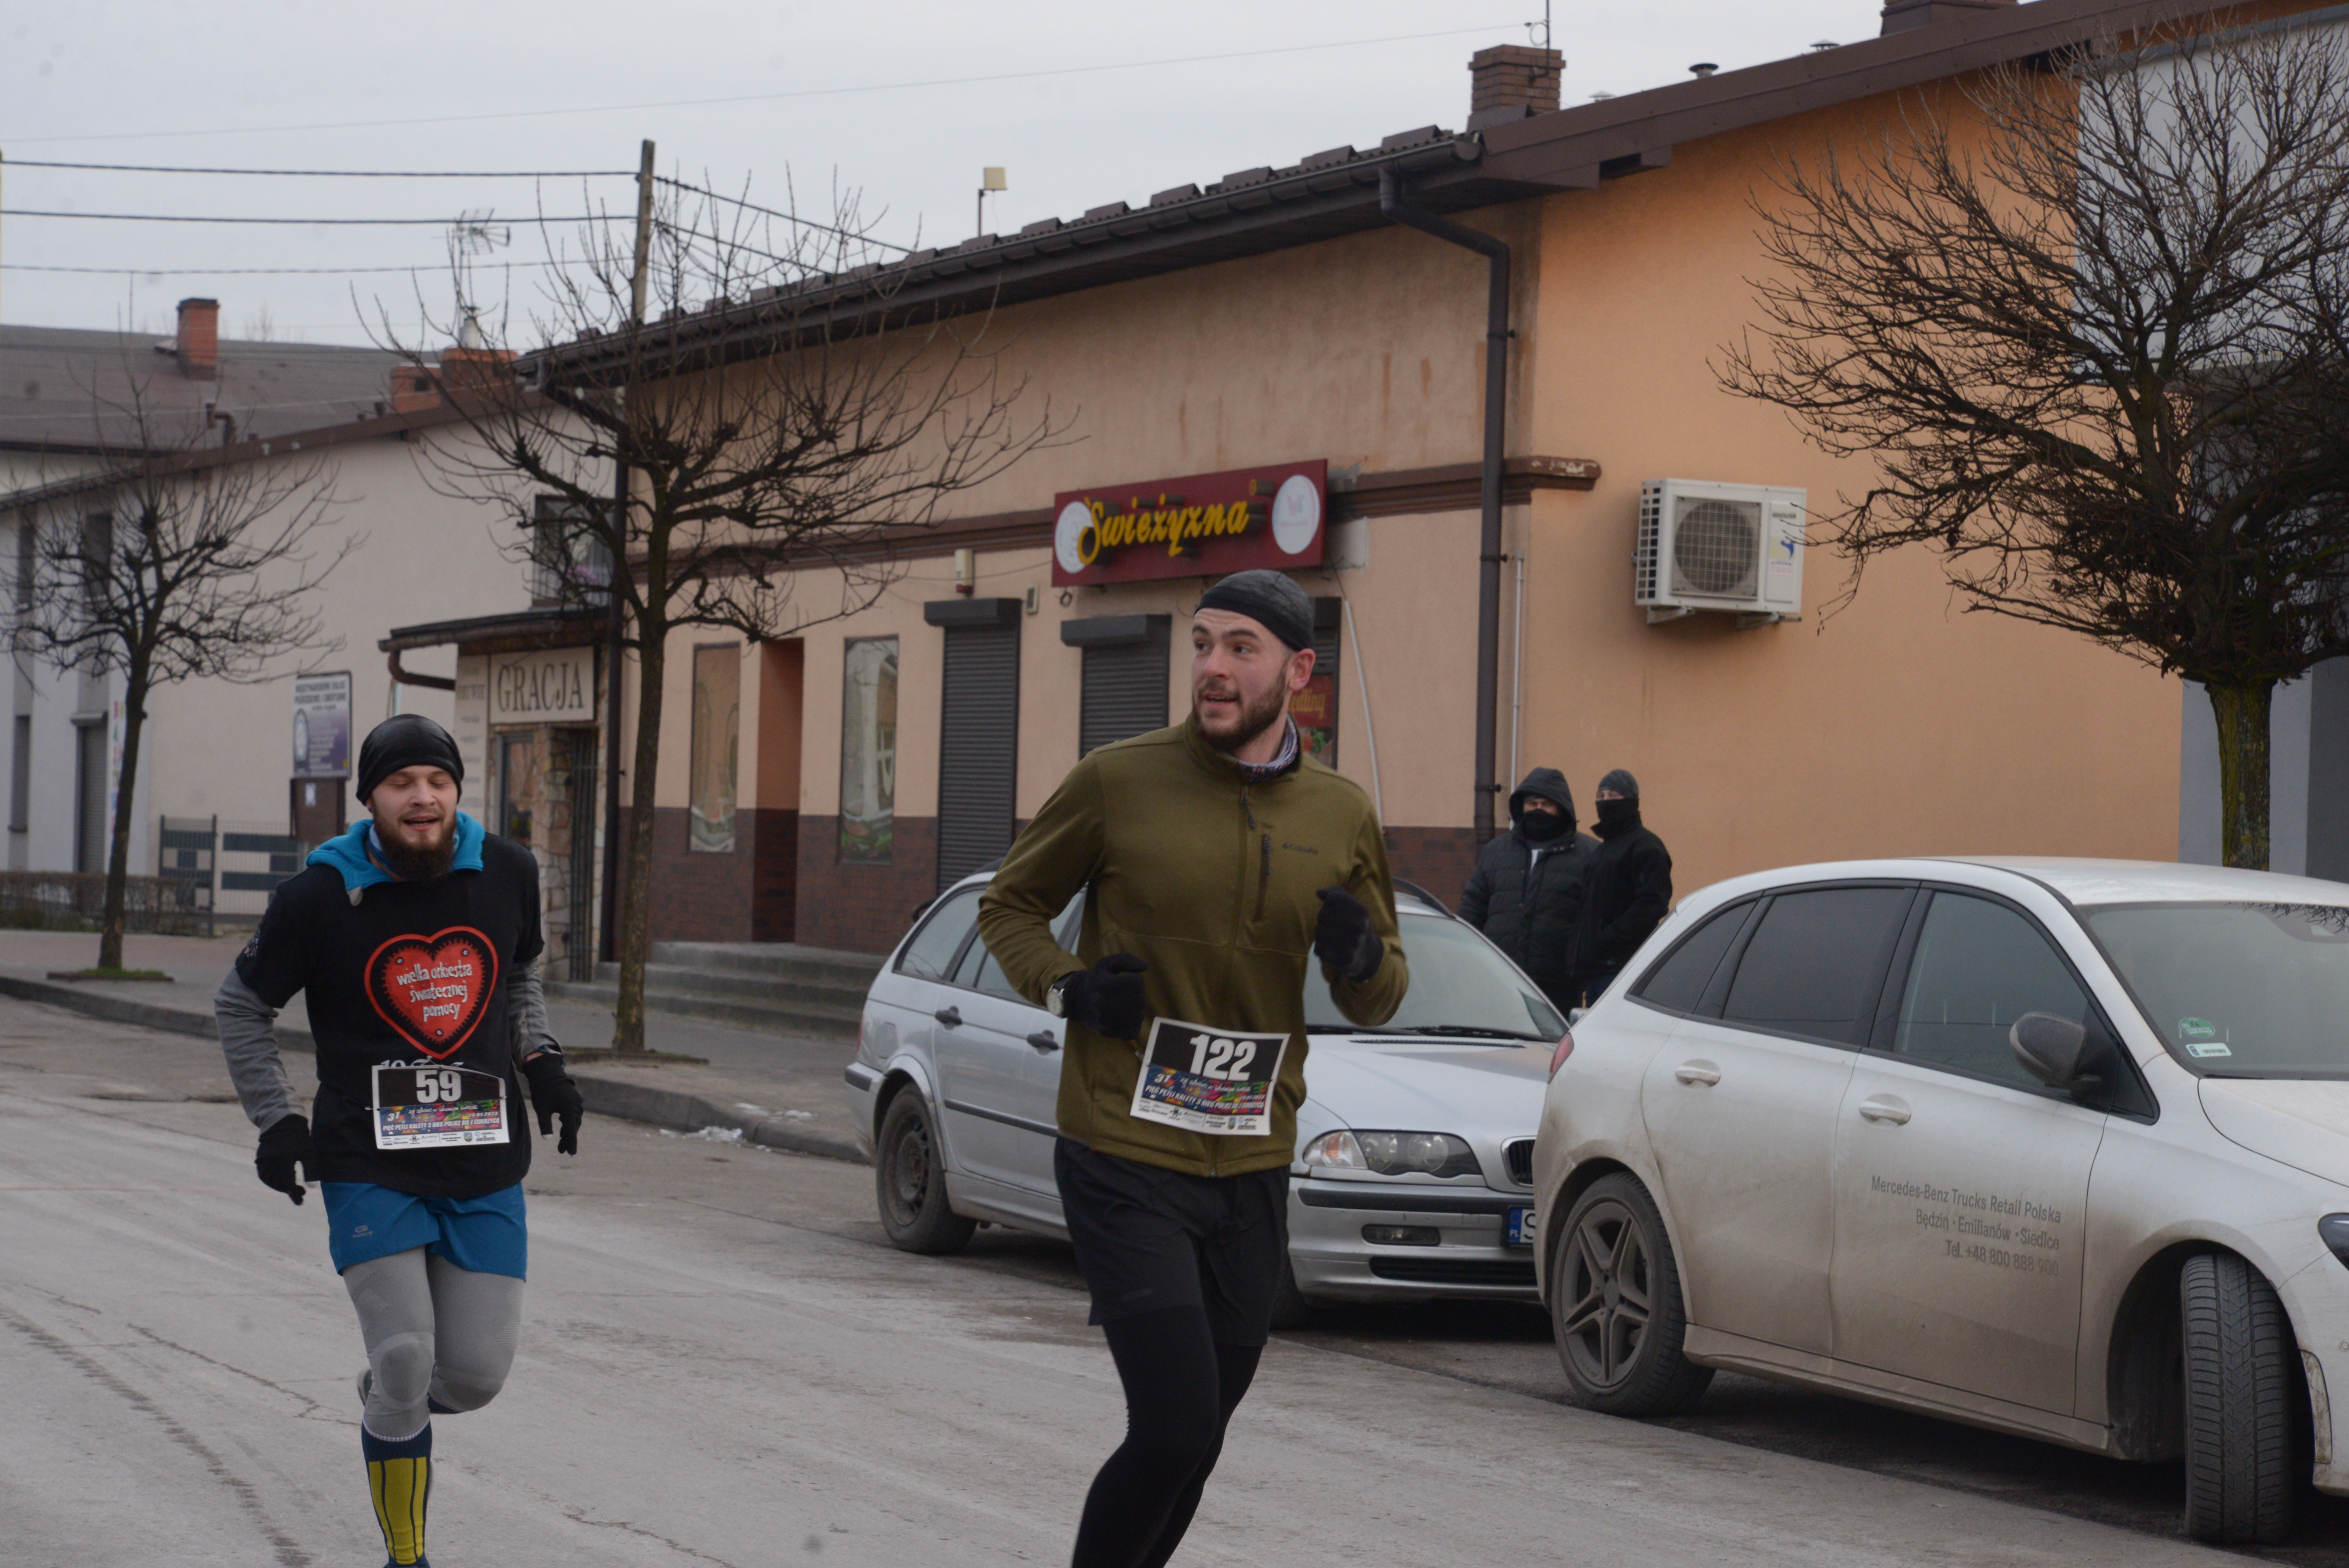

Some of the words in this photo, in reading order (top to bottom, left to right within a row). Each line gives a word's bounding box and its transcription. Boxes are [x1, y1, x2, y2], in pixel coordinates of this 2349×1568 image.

[497, 661, 584, 712] GRACJA
[396, 964, 430, 985] wielka
[431, 960, 472, 979] orkiestra
[410, 980, 468, 1003] świątecznej
[423, 1003, 460, 1022] pomocy
[1190, 1033, 1256, 1081] 122
[416, 1070, 462, 1103] 59
[1154, 1074, 1171, 1083] 31
[1174, 1092, 1197, 1103] KALETY
[388, 1111, 400, 1121] 31
[1871, 1175, 1949, 1203] Mercedes-Benz
[1952, 1188, 1987, 1210] Trucks
[1990, 1196, 2021, 1216] Retail
[2025, 1201, 2061, 1223] Polska
[1509, 1229, 1519, 1237] PL
[1916, 1208, 1949, 1230] Będzin
[1958, 1216, 2011, 1241] Emilianów
[2020, 1228, 2060, 1250] Siedlce
[1945, 1239, 1963, 1258] Tel.
[1966, 1245, 1986, 1262] +48
[1989, 1248, 2010, 1267] 800
[2013, 1253, 2034, 1272] 888
[2038, 1258, 2059, 1277] 900
